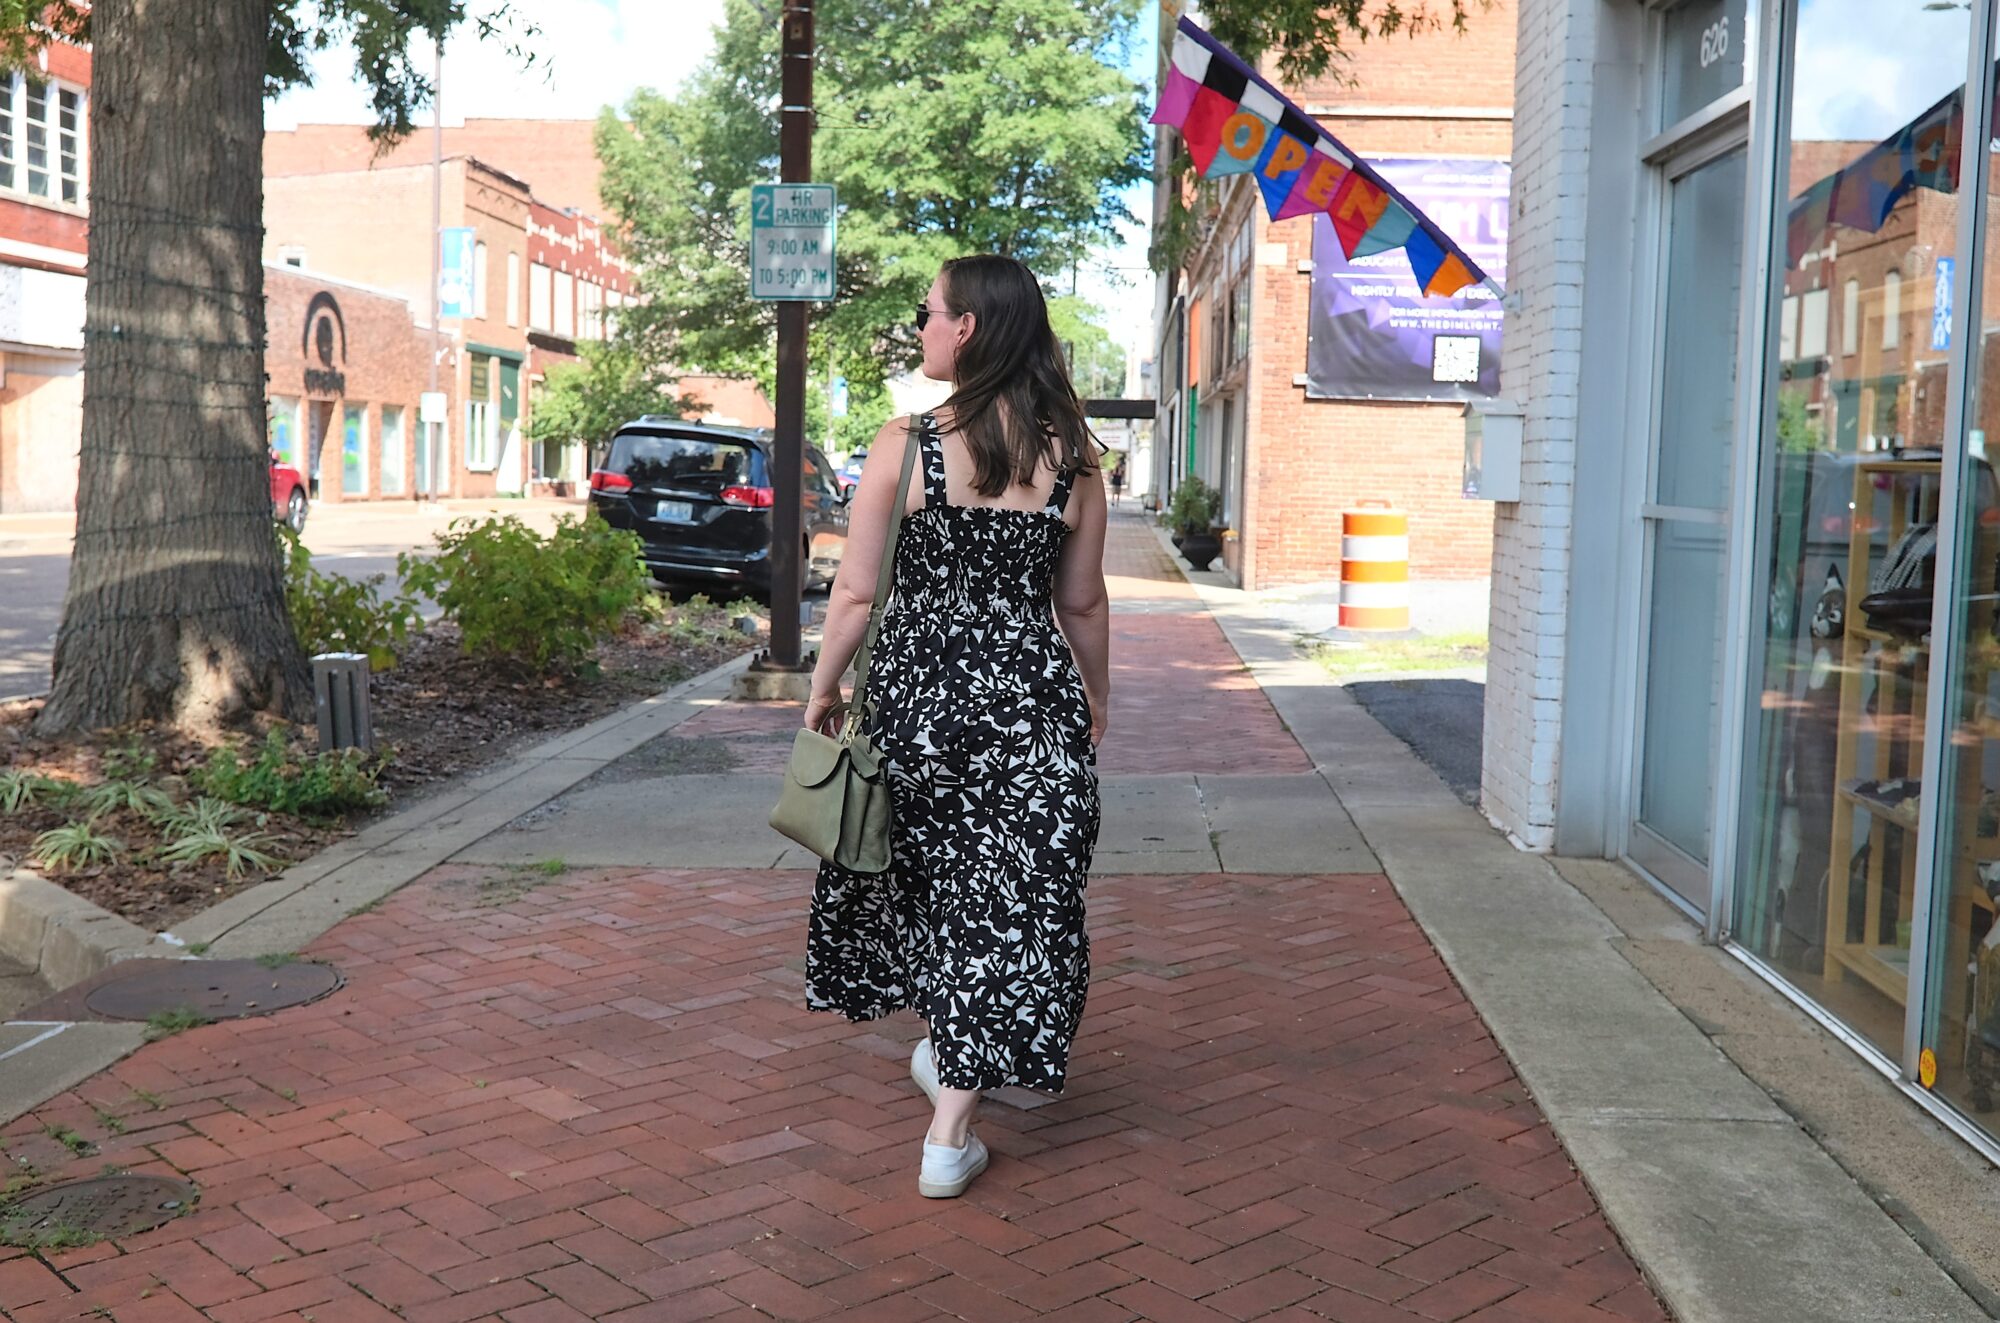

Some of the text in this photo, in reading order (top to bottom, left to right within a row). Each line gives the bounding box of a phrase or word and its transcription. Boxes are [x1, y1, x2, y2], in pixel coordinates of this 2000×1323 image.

[1700, 16, 1729, 68] 626
[1221, 113, 1391, 231] OPEN
[753, 190, 813, 220] 2 HR
[776, 208, 830, 224] PARKING
[767, 239, 819, 255] 9:00 AM
[760, 268, 827, 284] TO 5:00 PM
